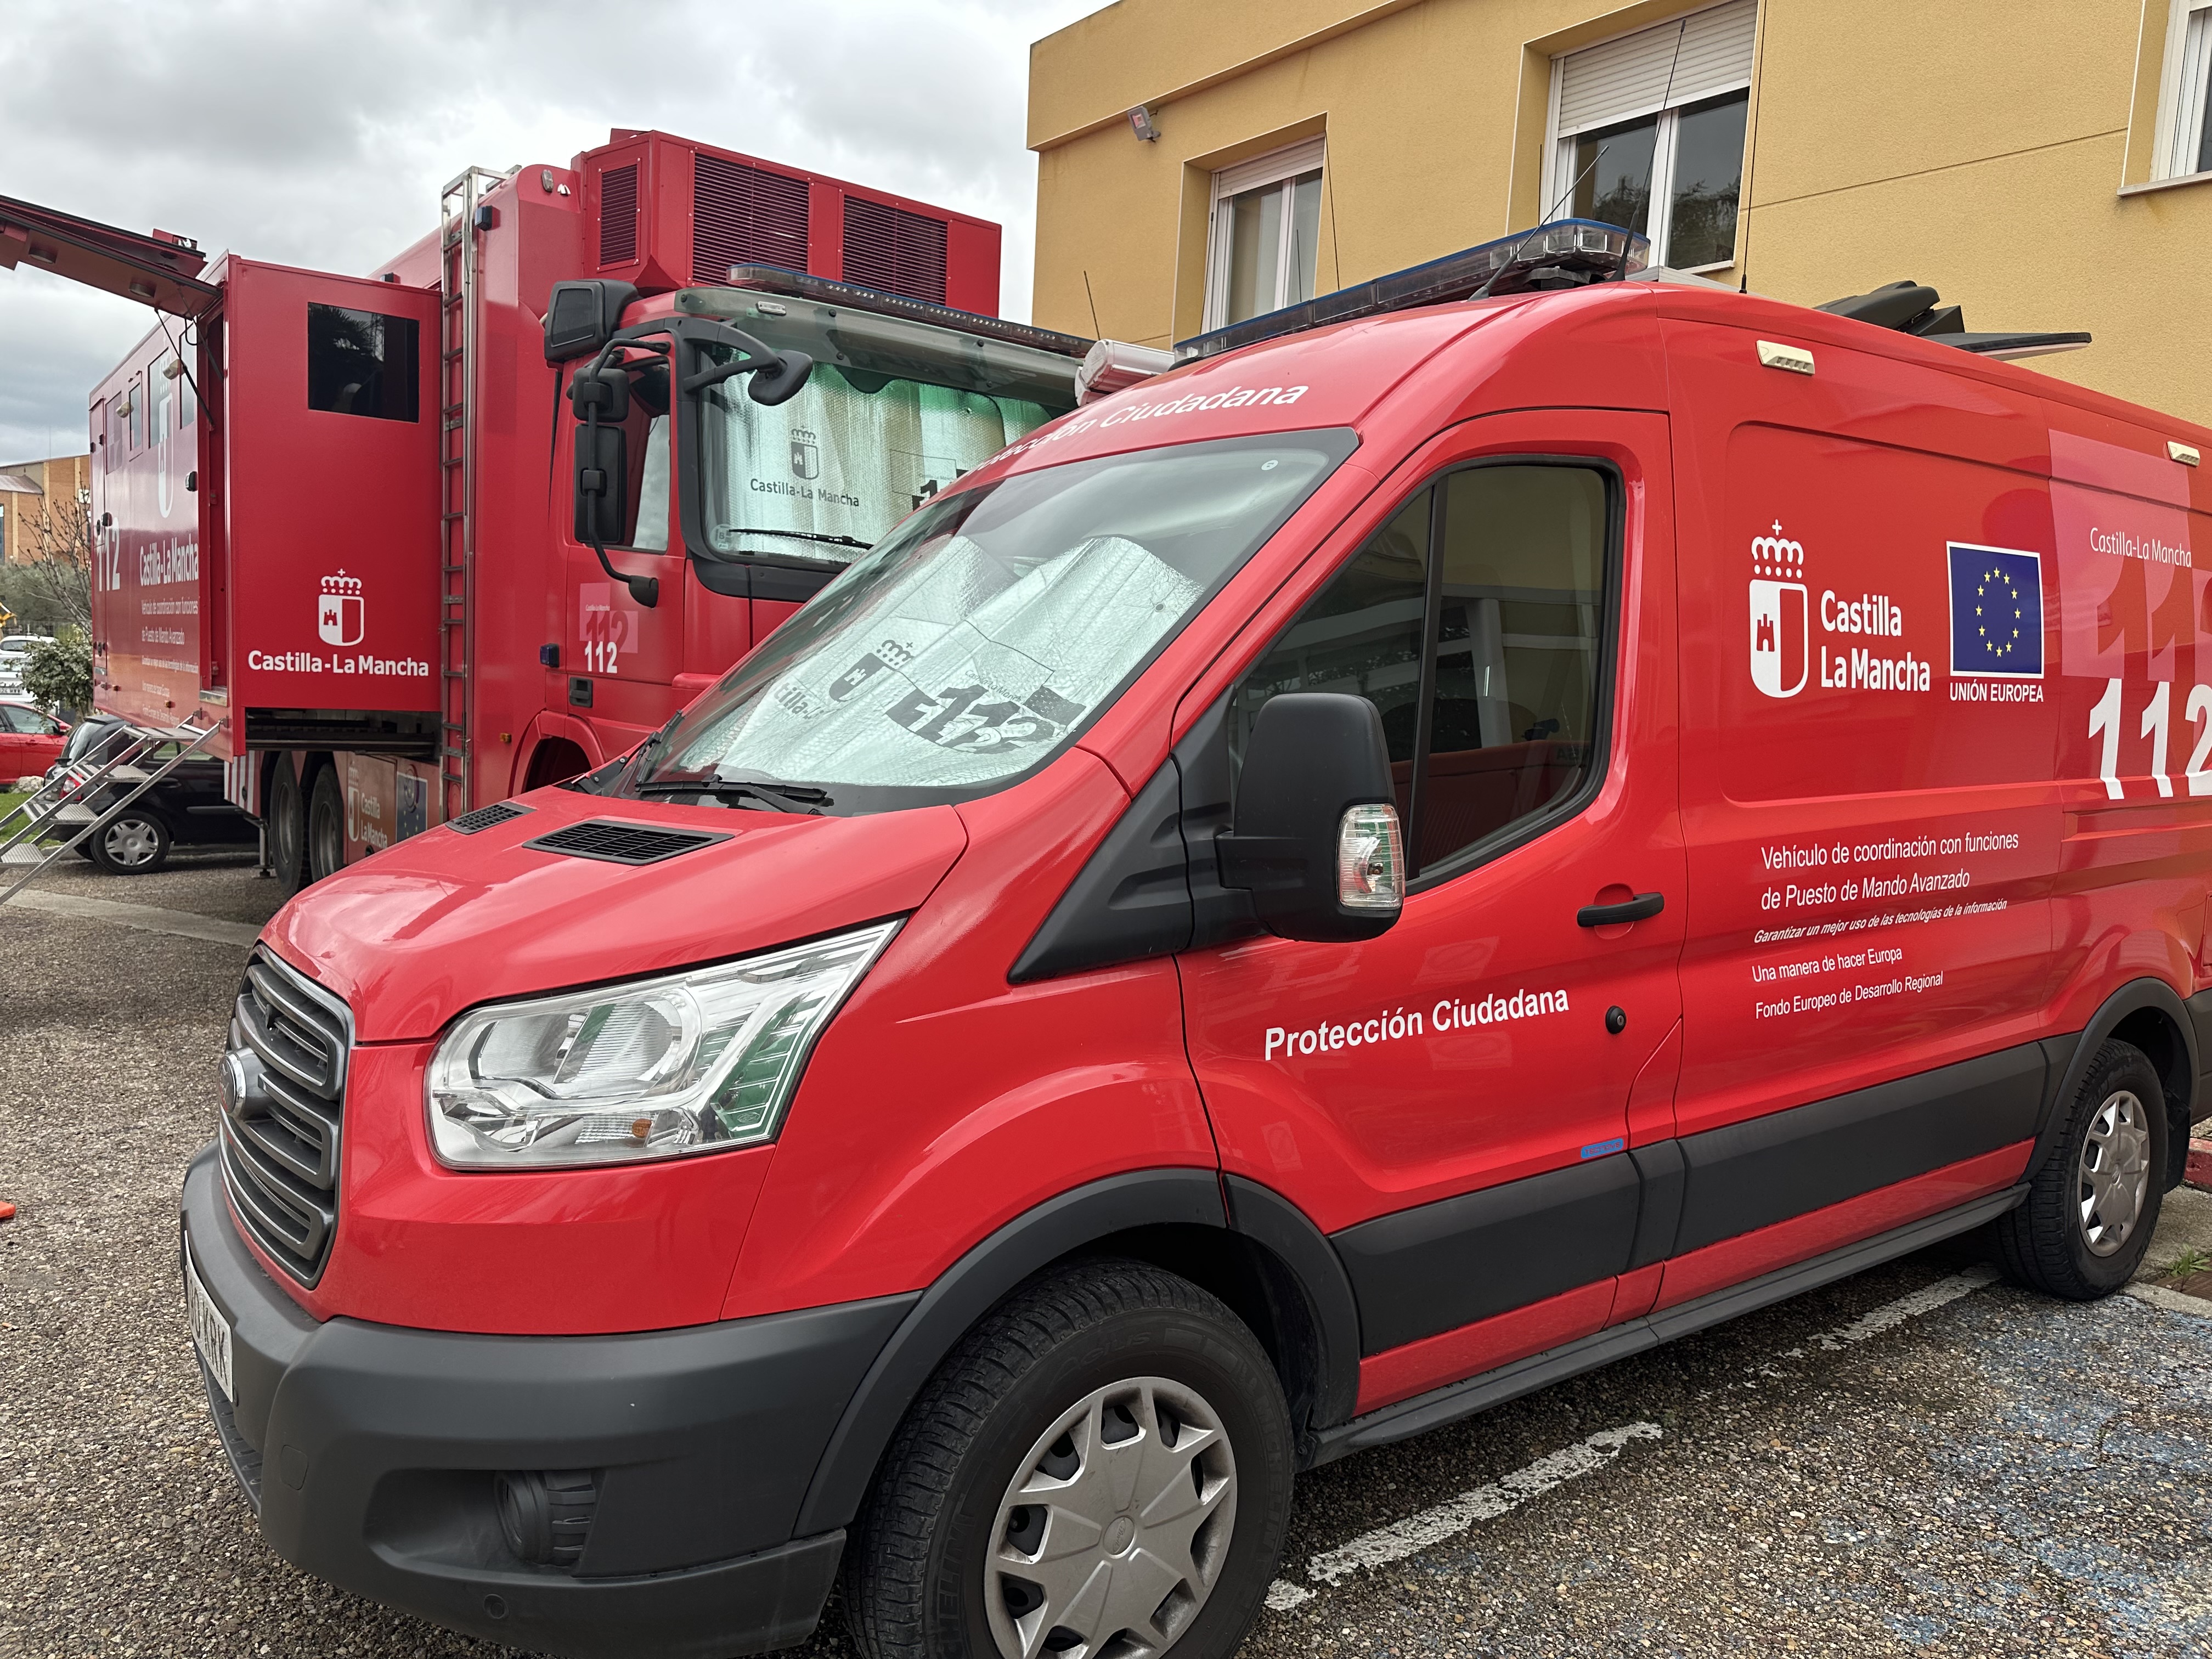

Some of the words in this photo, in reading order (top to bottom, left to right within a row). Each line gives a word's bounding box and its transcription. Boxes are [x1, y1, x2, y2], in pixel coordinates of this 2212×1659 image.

[1099, 385, 1309, 428] Ciudadana
[751, 478, 813, 499] Castilla-La
[818, 488, 859, 506] Mancha
[172, 533, 199, 583] Mancha
[2090, 528, 2149, 560] Castilla-La
[2152, 539, 2191, 567] Mancha
[1821, 590, 1901, 636] Castilla
[359, 655, 429, 676] Mancha
[585, 641, 618, 674] 112
[1821, 646, 1846, 688] La
[1852, 648, 1930, 691] Mancha
[996, 686, 1025, 704] Manch
[1950, 679, 1987, 701] UNIÓN
[1990, 684, 2044, 702] EUROPEA
[2088, 678, 2212, 800] 112
[361, 792, 380, 819] Castilla
[1761, 843, 1827, 869] Vehículo
[1832, 842, 1849, 864] de
[1854, 836, 1936, 862] coordinación
[1940, 838, 1961, 854] con
[1965, 831, 2018, 852] funciones
[1762, 887, 1780, 910] de
[1786, 882, 1836, 907] Puesto
[1841, 879, 1858, 901] de
[1862, 874, 1907, 899] Mando
[1909, 868, 1970, 893] Avanzado
[1754, 926, 1807, 943] Garantizar
[1807, 926, 1820, 936] un
[1820, 919, 1849, 935] mejor
[1849, 919, 1866, 930] uso
[1868, 915, 1880, 927] de
[1880, 913, 1894, 926] las
[1895, 907, 1943, 923] tecnologías
[1943, 905, 1954, 917] de
[1954, 904, 1962, 916] la
[1963, 898, 2007, 915] información
[1752, 966, 1776, 982] Una
[1779, 961, 1820, 978] manera
[1822, 956, 1835, 972] de
[1837, 953, 1865, 969] hacer
[1867, 949, 1902, 964] Europa
[1756, 998, 1790, 1019] Fondo
[1794, 994, 1836, 1012] Europeo
[1839, 988, 1852, 1003] de
[1855, 979, 1902, 1000] Desarrollo
[1905, 970, 1943, 992] Regional
[1265, 1007, 1423, 1060] Protección
[1432, 989, 1569, 1031] Ciudadana
